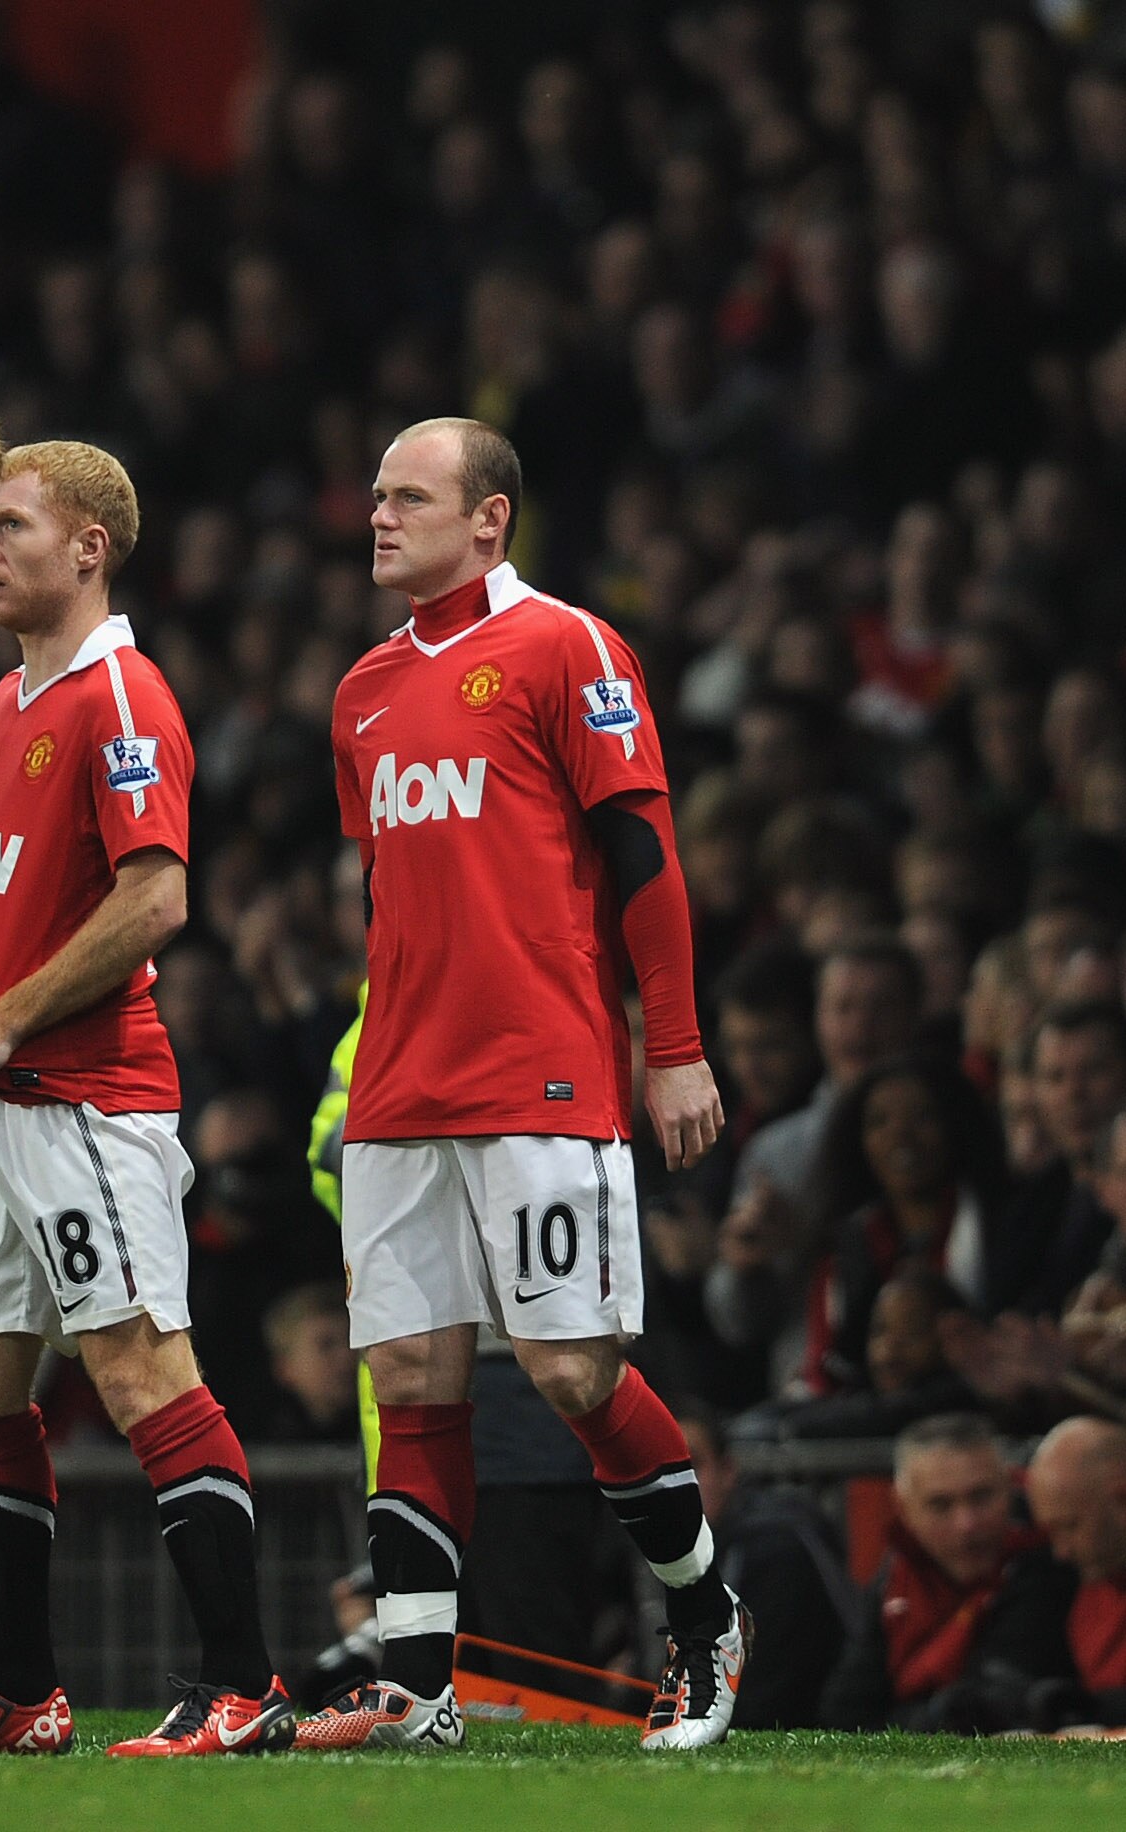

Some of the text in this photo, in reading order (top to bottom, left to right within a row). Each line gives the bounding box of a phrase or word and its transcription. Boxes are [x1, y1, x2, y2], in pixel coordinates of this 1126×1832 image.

[594, 711, 632, 724] BARCLAYS
[110, 768, 146, 783] BARCLAYS
[370, 752, 487, 837] AON
[34, 1207, 102, 1291] 18
[513, 1201, 580, 1281] 10
